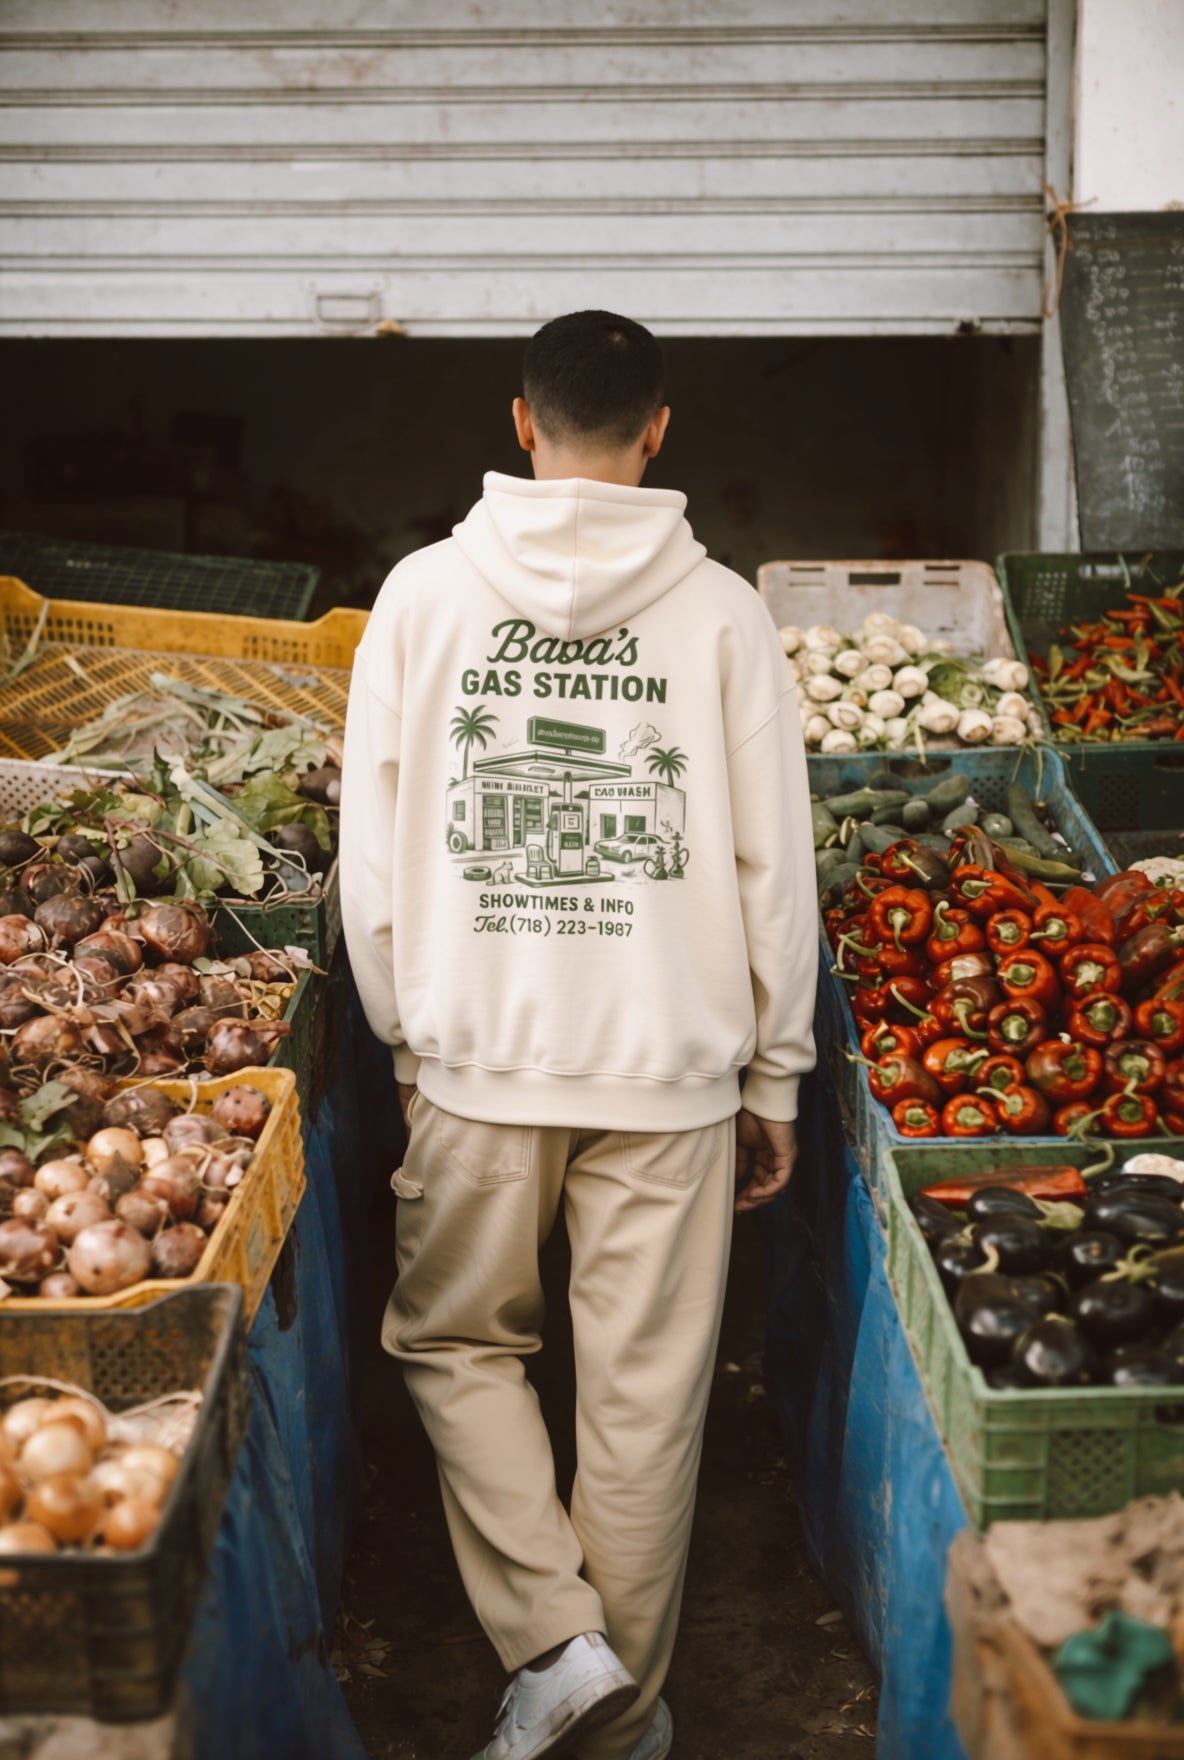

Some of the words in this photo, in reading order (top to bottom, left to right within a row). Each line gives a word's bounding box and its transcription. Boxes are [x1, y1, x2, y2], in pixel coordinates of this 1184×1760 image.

[461, 669, 522, 697] GAS
[533, 672, 667, 704] STATION
[479, 893, 578, 911] SHOWTIMES
[583, 897, 594, 912] &
[600, 898, 634, 915] INFO
